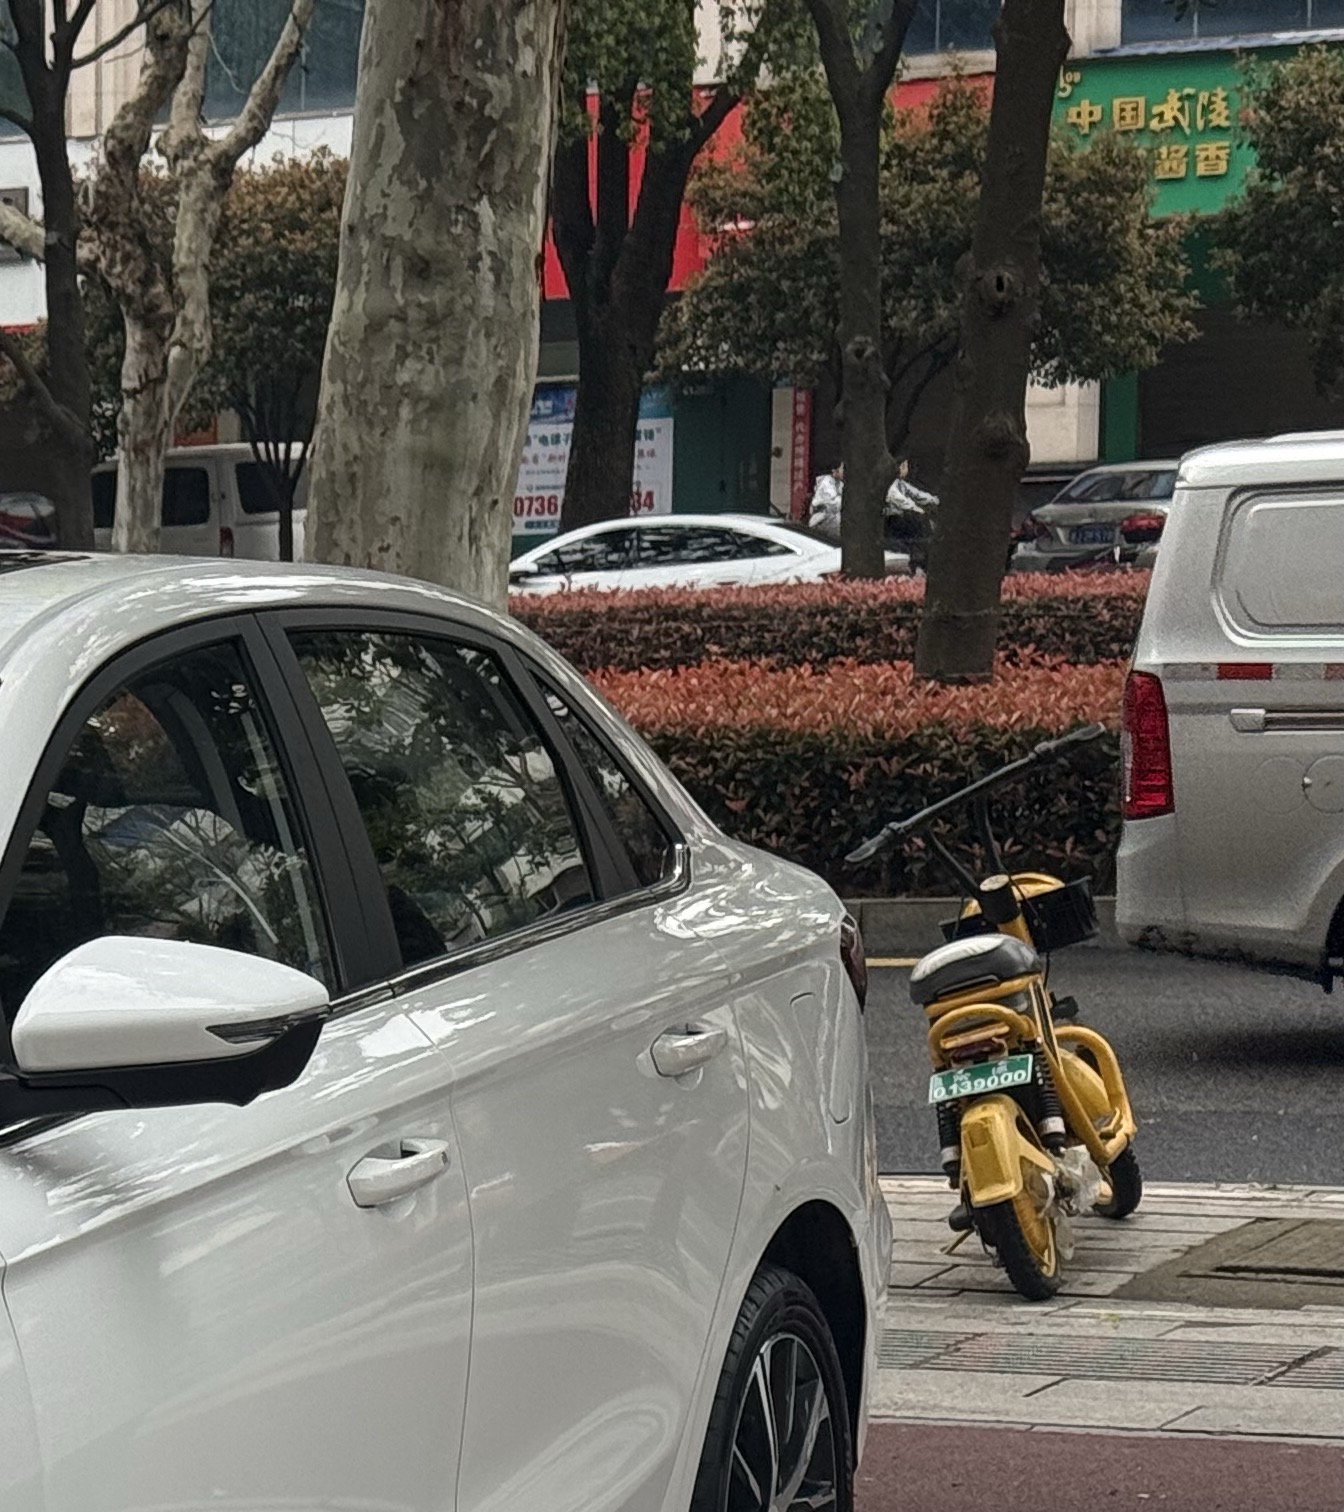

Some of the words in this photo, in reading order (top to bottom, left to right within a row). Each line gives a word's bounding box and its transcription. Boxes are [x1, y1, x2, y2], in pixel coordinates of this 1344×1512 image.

[1067, 87, 1230, 136] 中国武陵
[1155, 141, 1230, 180] 酱香
[513, 495, 559, 517] 0736
